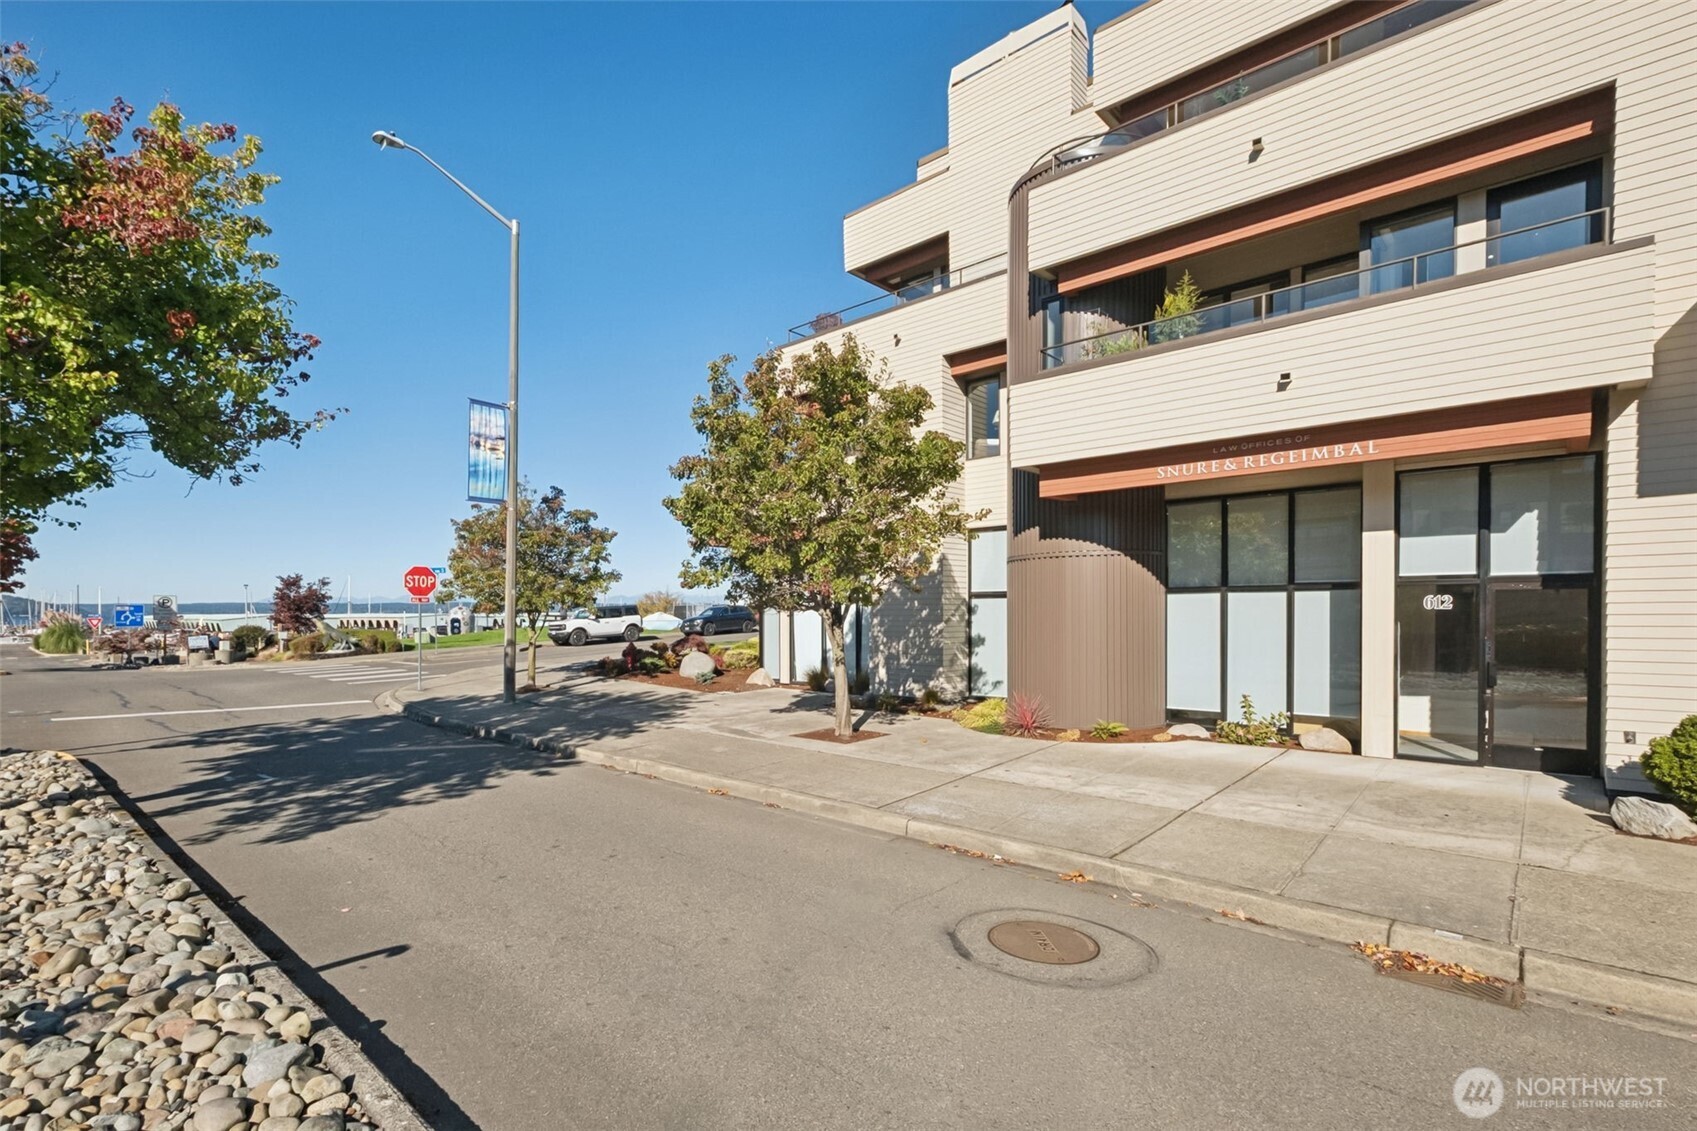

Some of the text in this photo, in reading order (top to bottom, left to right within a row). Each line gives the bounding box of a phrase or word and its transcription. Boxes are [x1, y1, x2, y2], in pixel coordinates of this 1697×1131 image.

[1212, 434, 1311, 454] LAW OFFICES OF
[1244, 440, 1379, 469] REGEIMBAL
[405, 575, 435, 587] STOP
[1422, 594, 1454, 610] 612
